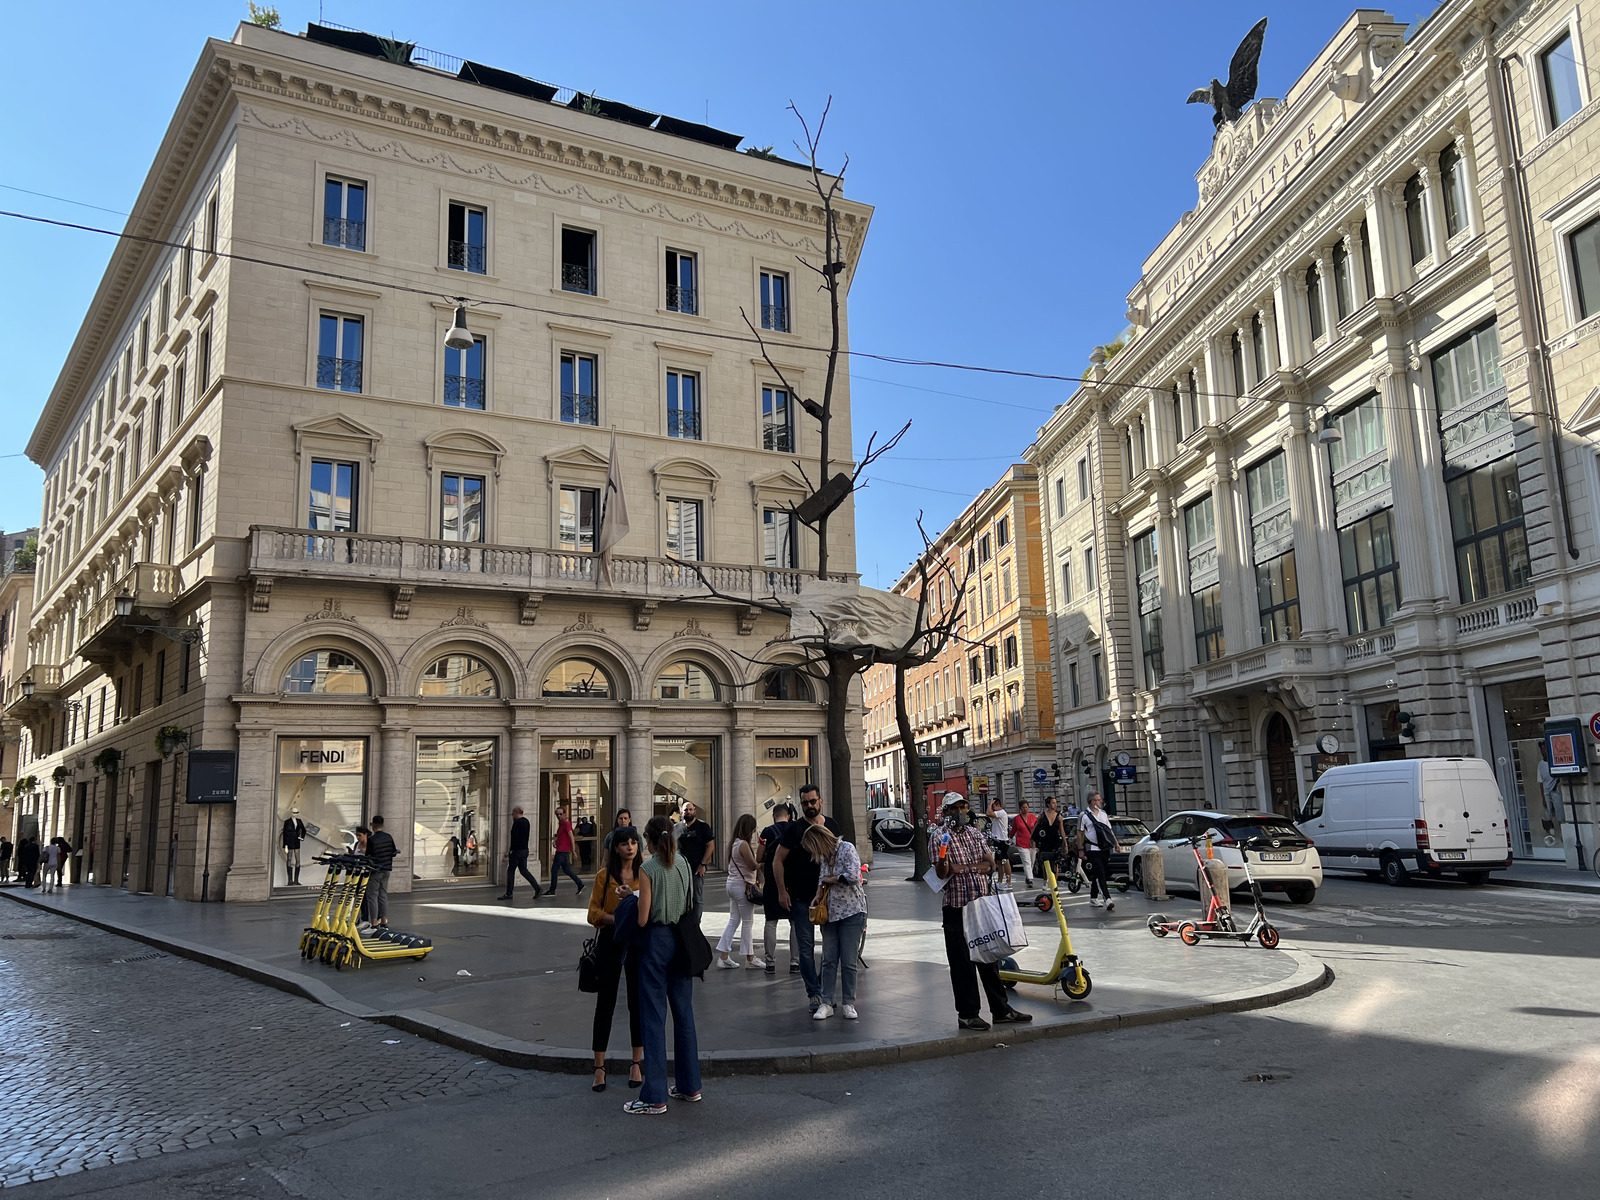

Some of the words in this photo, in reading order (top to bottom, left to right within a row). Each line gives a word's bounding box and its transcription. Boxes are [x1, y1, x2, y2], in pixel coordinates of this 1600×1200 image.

[1165, 236, 1213, 295] UNIONE
[1232, 122, 1316, 226] MILITARE
[300, 750, 344, 763] FENDI
[557, 748, 594, 760] FENDI
[768, 747, 799, 758] FENDI
[1554, 755, 1573, 763] TINTIN
